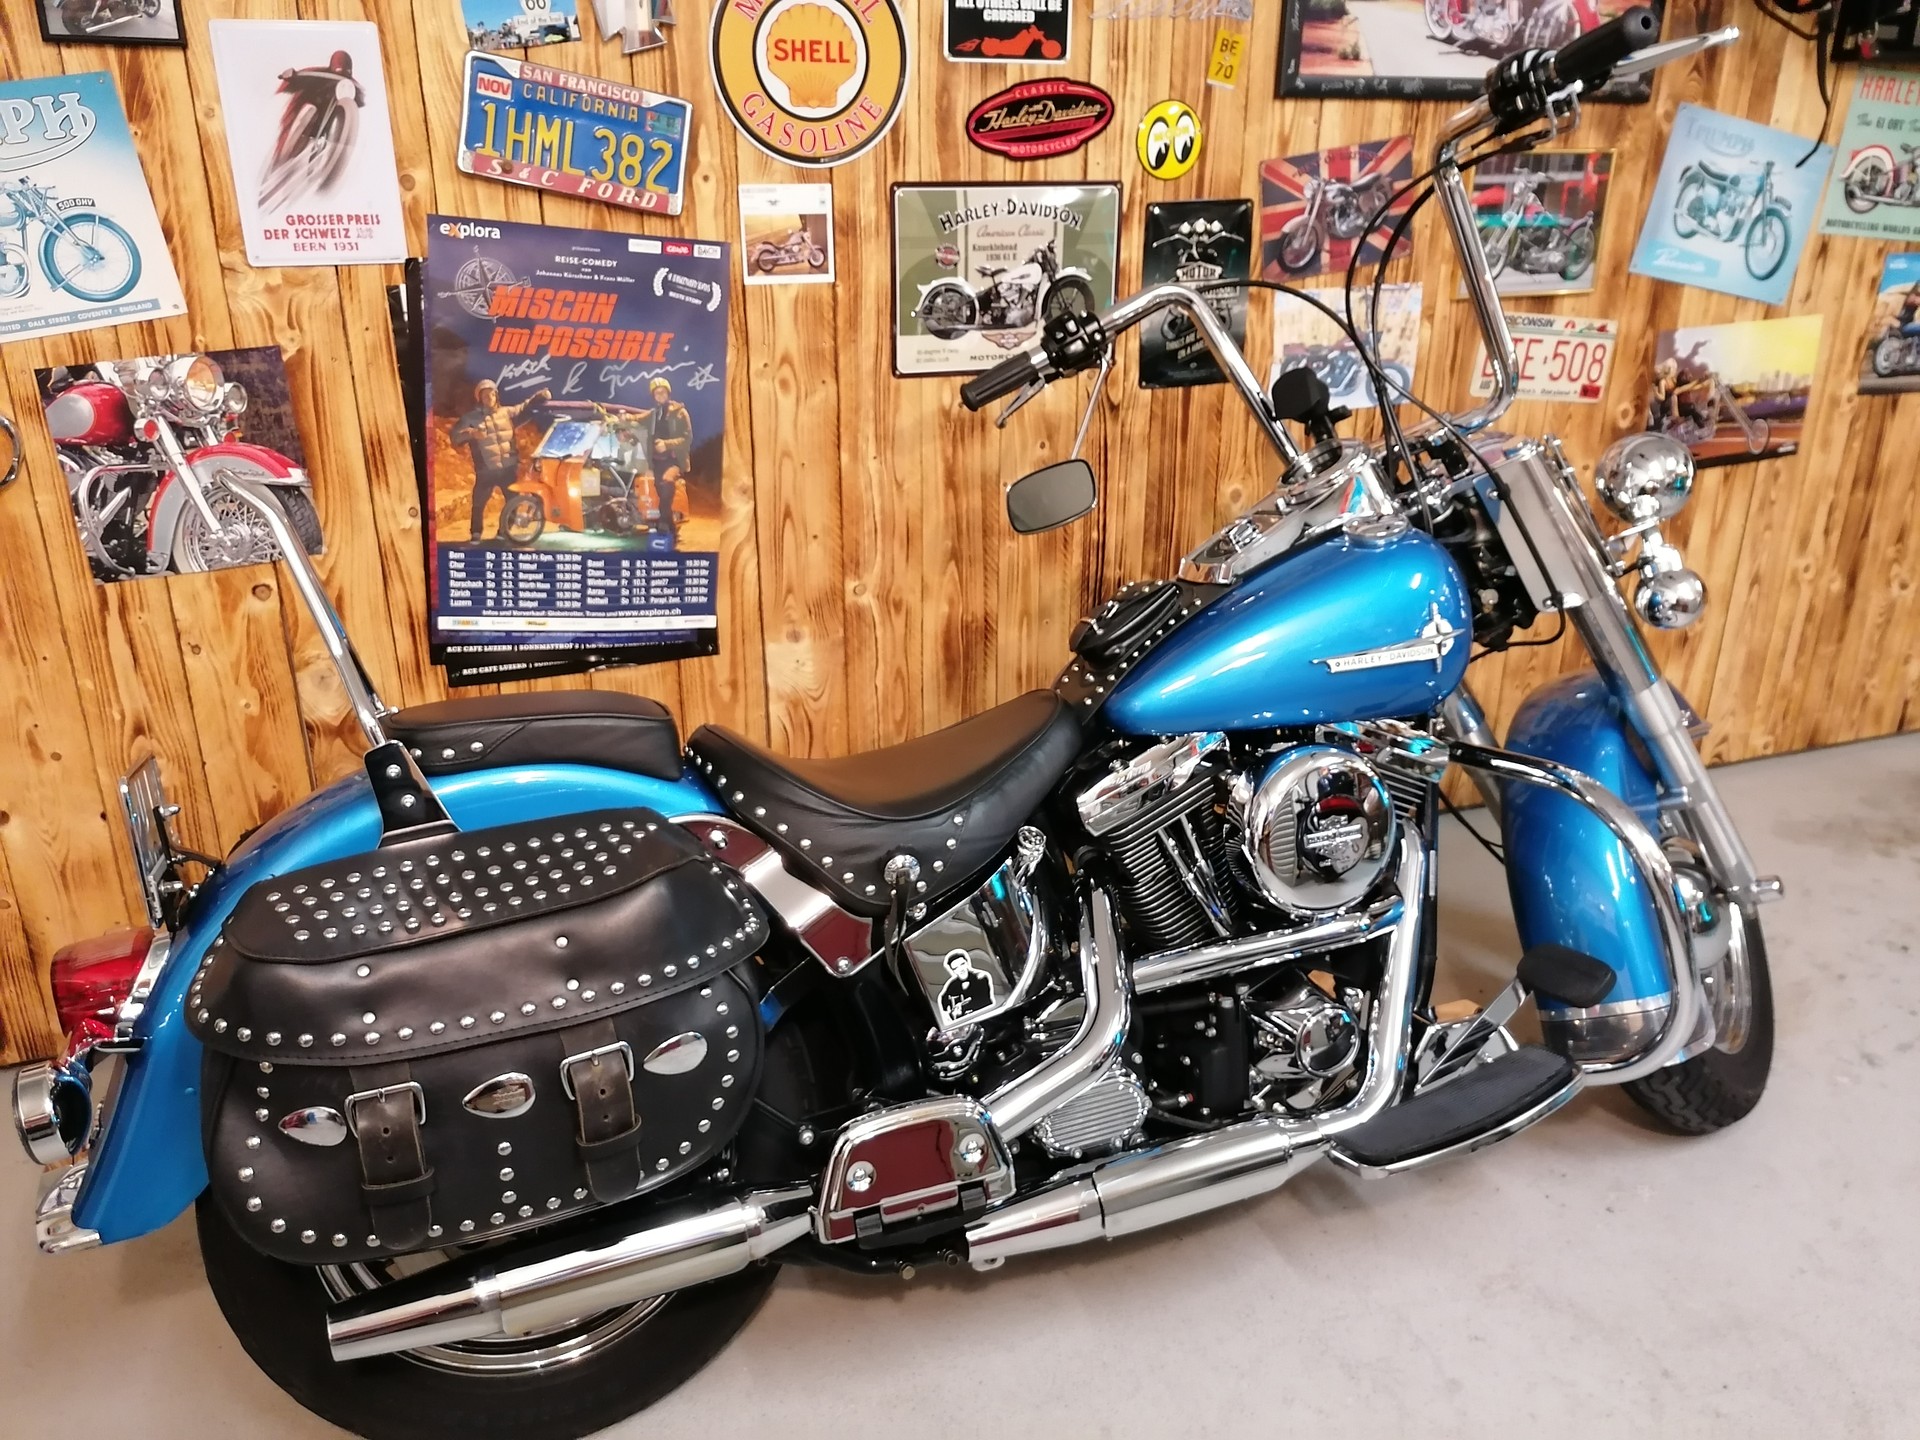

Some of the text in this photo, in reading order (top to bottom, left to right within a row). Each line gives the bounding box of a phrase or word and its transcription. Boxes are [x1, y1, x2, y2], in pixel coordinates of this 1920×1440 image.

[983, 9, 1035, 23] CRUSHED
[774, 38, 850, 64] SHELL
[1220, 38, 1239, 56] BE
[1215, 61, 1234, 79] 70
[478, 77, 512, 96] NOV
[522, 65, 640, 104] SAN FRANCISCO
[1014, 84, 1065, 98] CLASSIC
[523, 83, 639, 123] CALIFORNIA
[742, 93, 882, 153] GASOLINE
[979, 100, 1106, 132] Harley-Davidson
[1010, 137, 1078, 154] MOTORCYCLES
[487, 159, 658, 209] S & C FORD
[58, 199, 75, 210] 500
[286, 214, 381, 226] GROSSER PREIS
[264, 229, 289, 240] DER
[295, 228, 351, 240] SCHWEIZ
[439, 222, 501, 240] explora
[293, 242, 327, 252] BERN
[554, 255, 618, 268] REISE-COMEDY
[488, 285, 618, 325] MISCHN
[28, 320, 46, 328] DALE
[1504, 315, 1555, 328] SCONSIN
[488, 325, 674, 363] imPOSSIBLE
[618, 608, 682, 617] www.explora.ch
[463, 645, 483, 653] CAFE
[484, 644, 513, 652] LUZERN
[462, 667, 478, 676] ACE
[479, 666, 498, 674] CAFE
[499, 663, 528, 672] LUZERN
